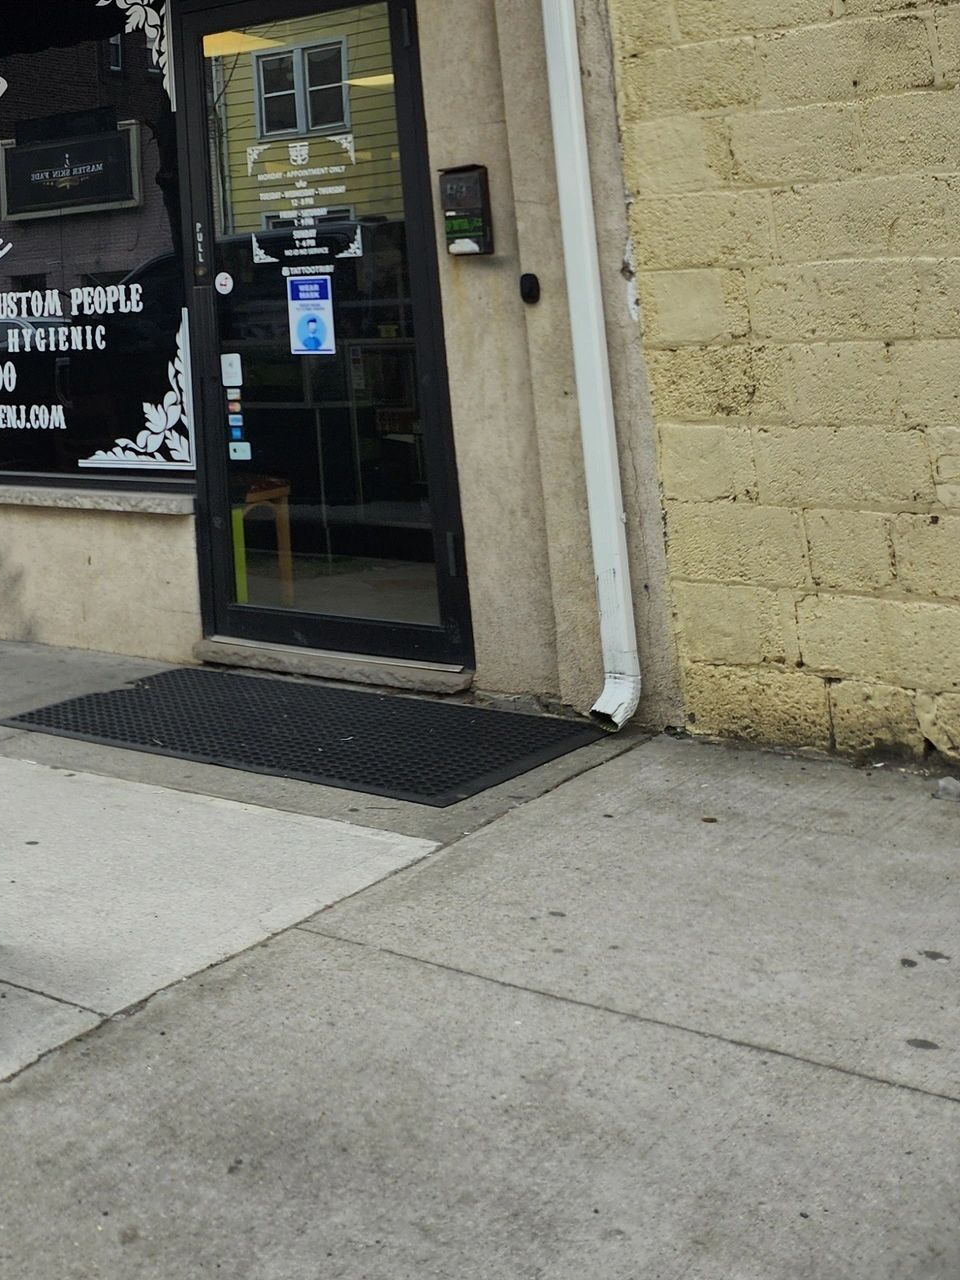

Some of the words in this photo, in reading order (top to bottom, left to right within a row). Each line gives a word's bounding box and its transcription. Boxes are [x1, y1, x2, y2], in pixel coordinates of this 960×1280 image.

[196, 222, 204, 263] PULL
[70, 283, 144, 316] PEOPLE
[7, 325, 107, 353] HYGIENIC
